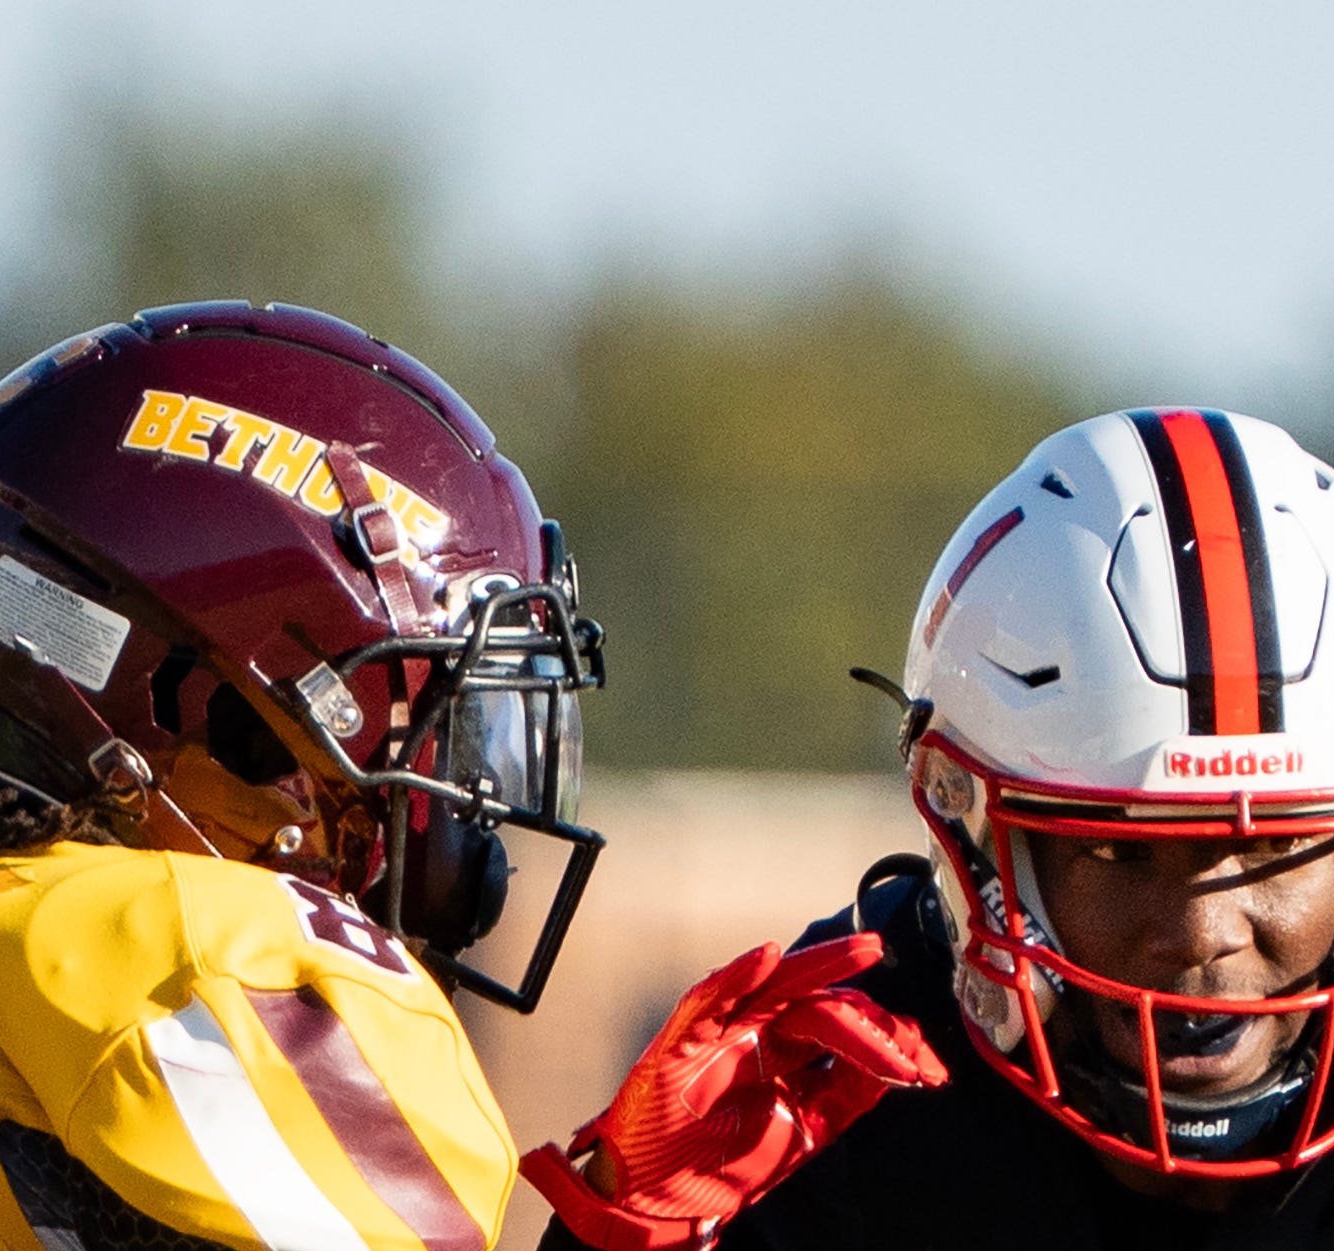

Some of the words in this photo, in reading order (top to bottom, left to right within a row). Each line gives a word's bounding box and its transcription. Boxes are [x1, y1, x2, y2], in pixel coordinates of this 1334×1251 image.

[35, 576, 85, 609] WARNING
[1164, 748, 1303, 777] Riddell
[1165, 1117, 1230, 1138] iddell
